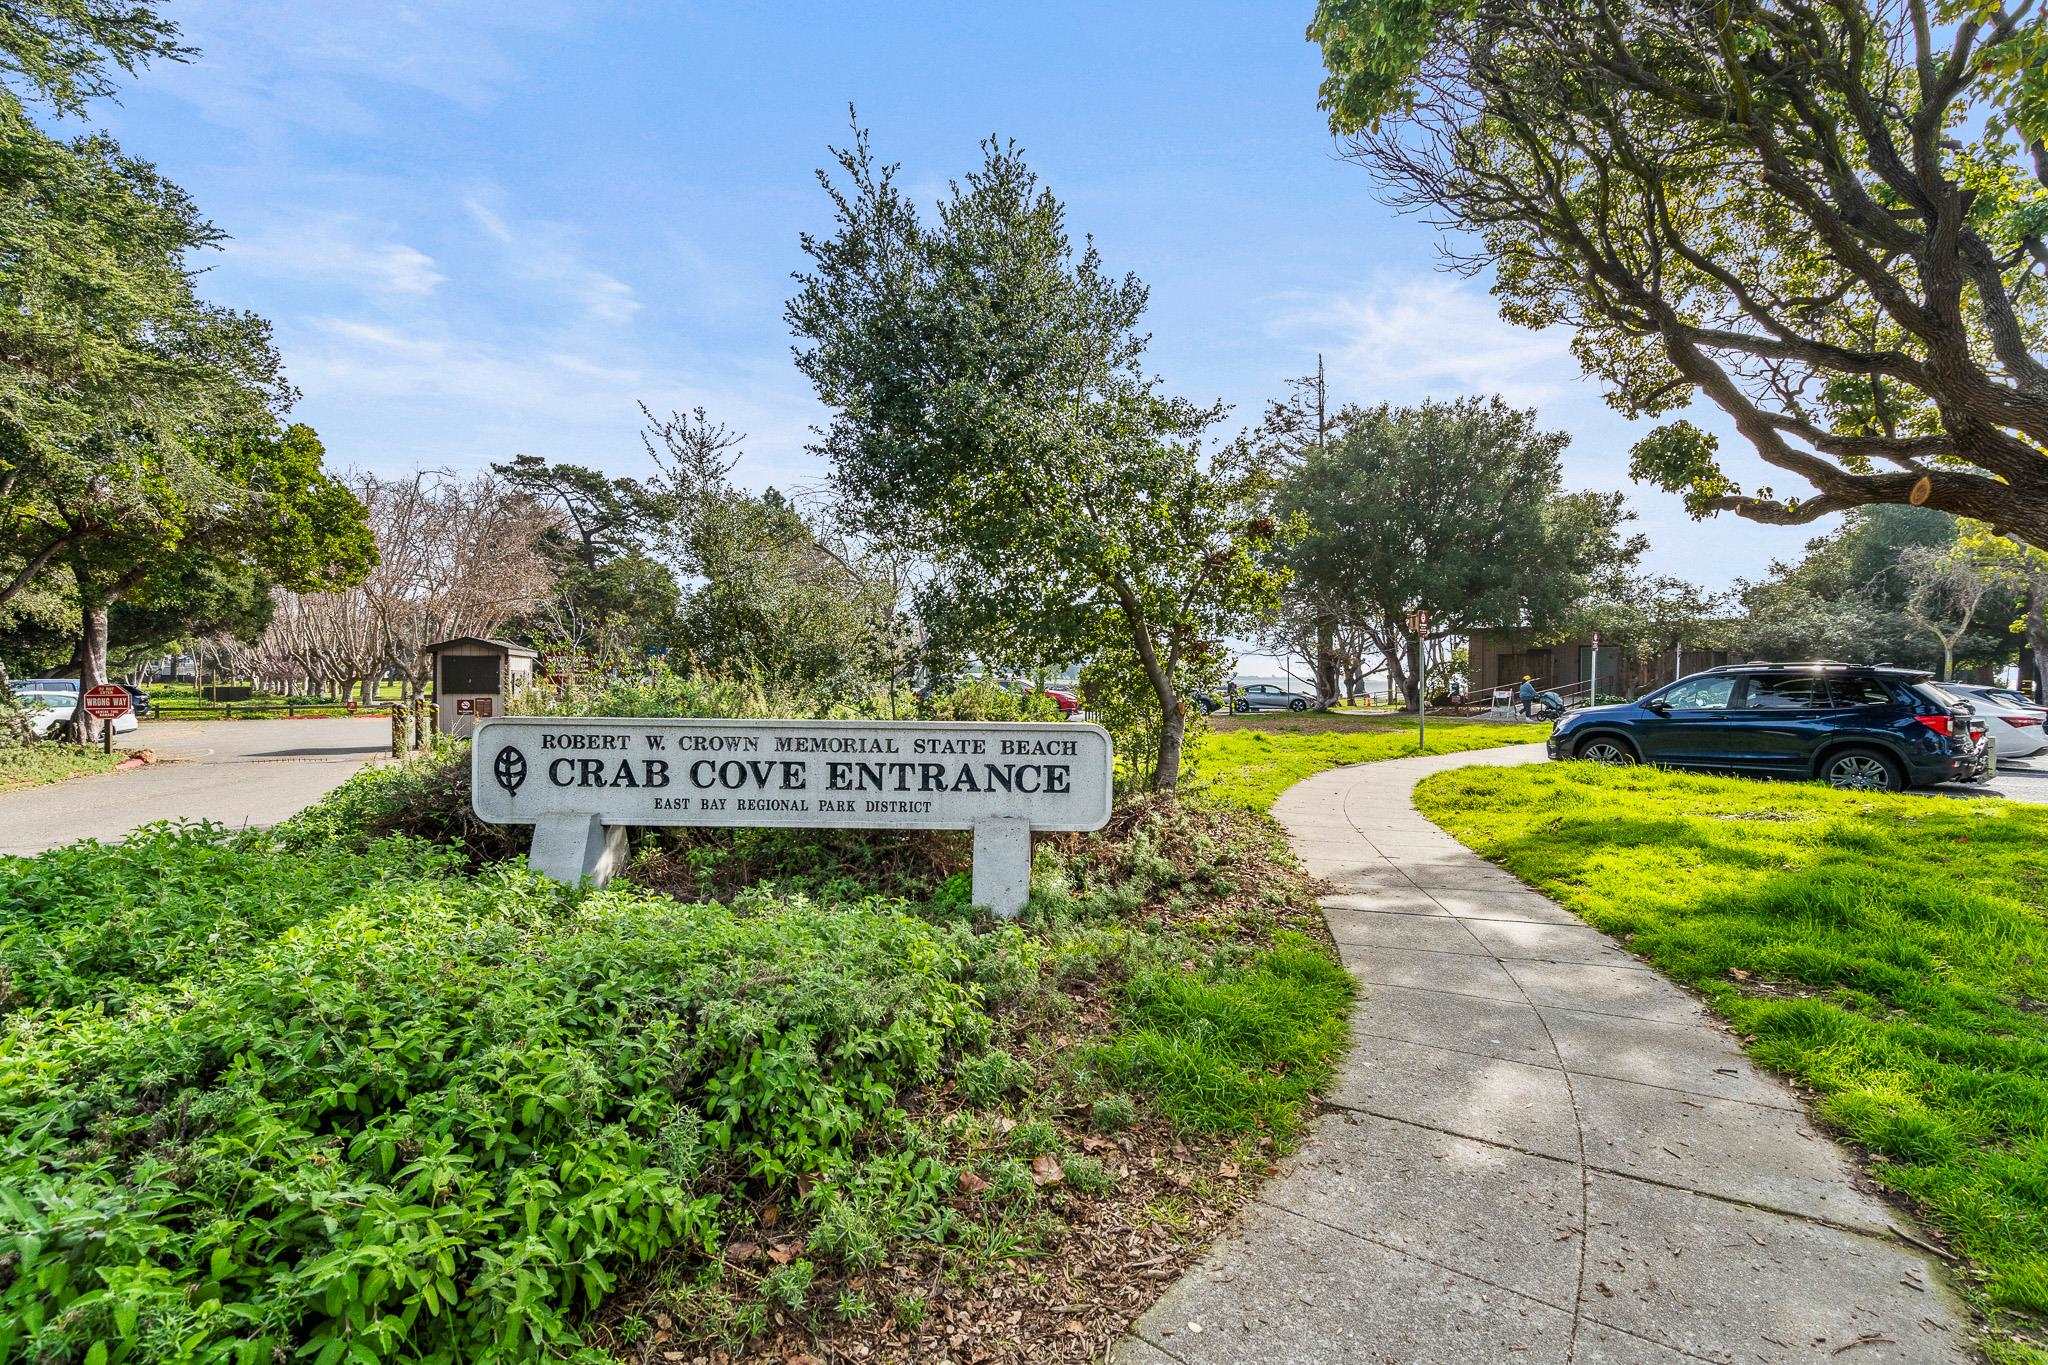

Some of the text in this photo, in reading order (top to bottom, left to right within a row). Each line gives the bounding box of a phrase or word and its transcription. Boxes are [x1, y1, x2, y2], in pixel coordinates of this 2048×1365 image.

[86, 697, 127, 706] WRONG WAY
[541, 734, 1078, 757] ROBERT W. CROWN MEMORIAL STATE BEACH
[549, 758, 1071, 795] CRAB COVE ENTRANCE
[655, 798, 933, 815] EAST BAY REGIONAL PARK DISTRICT
